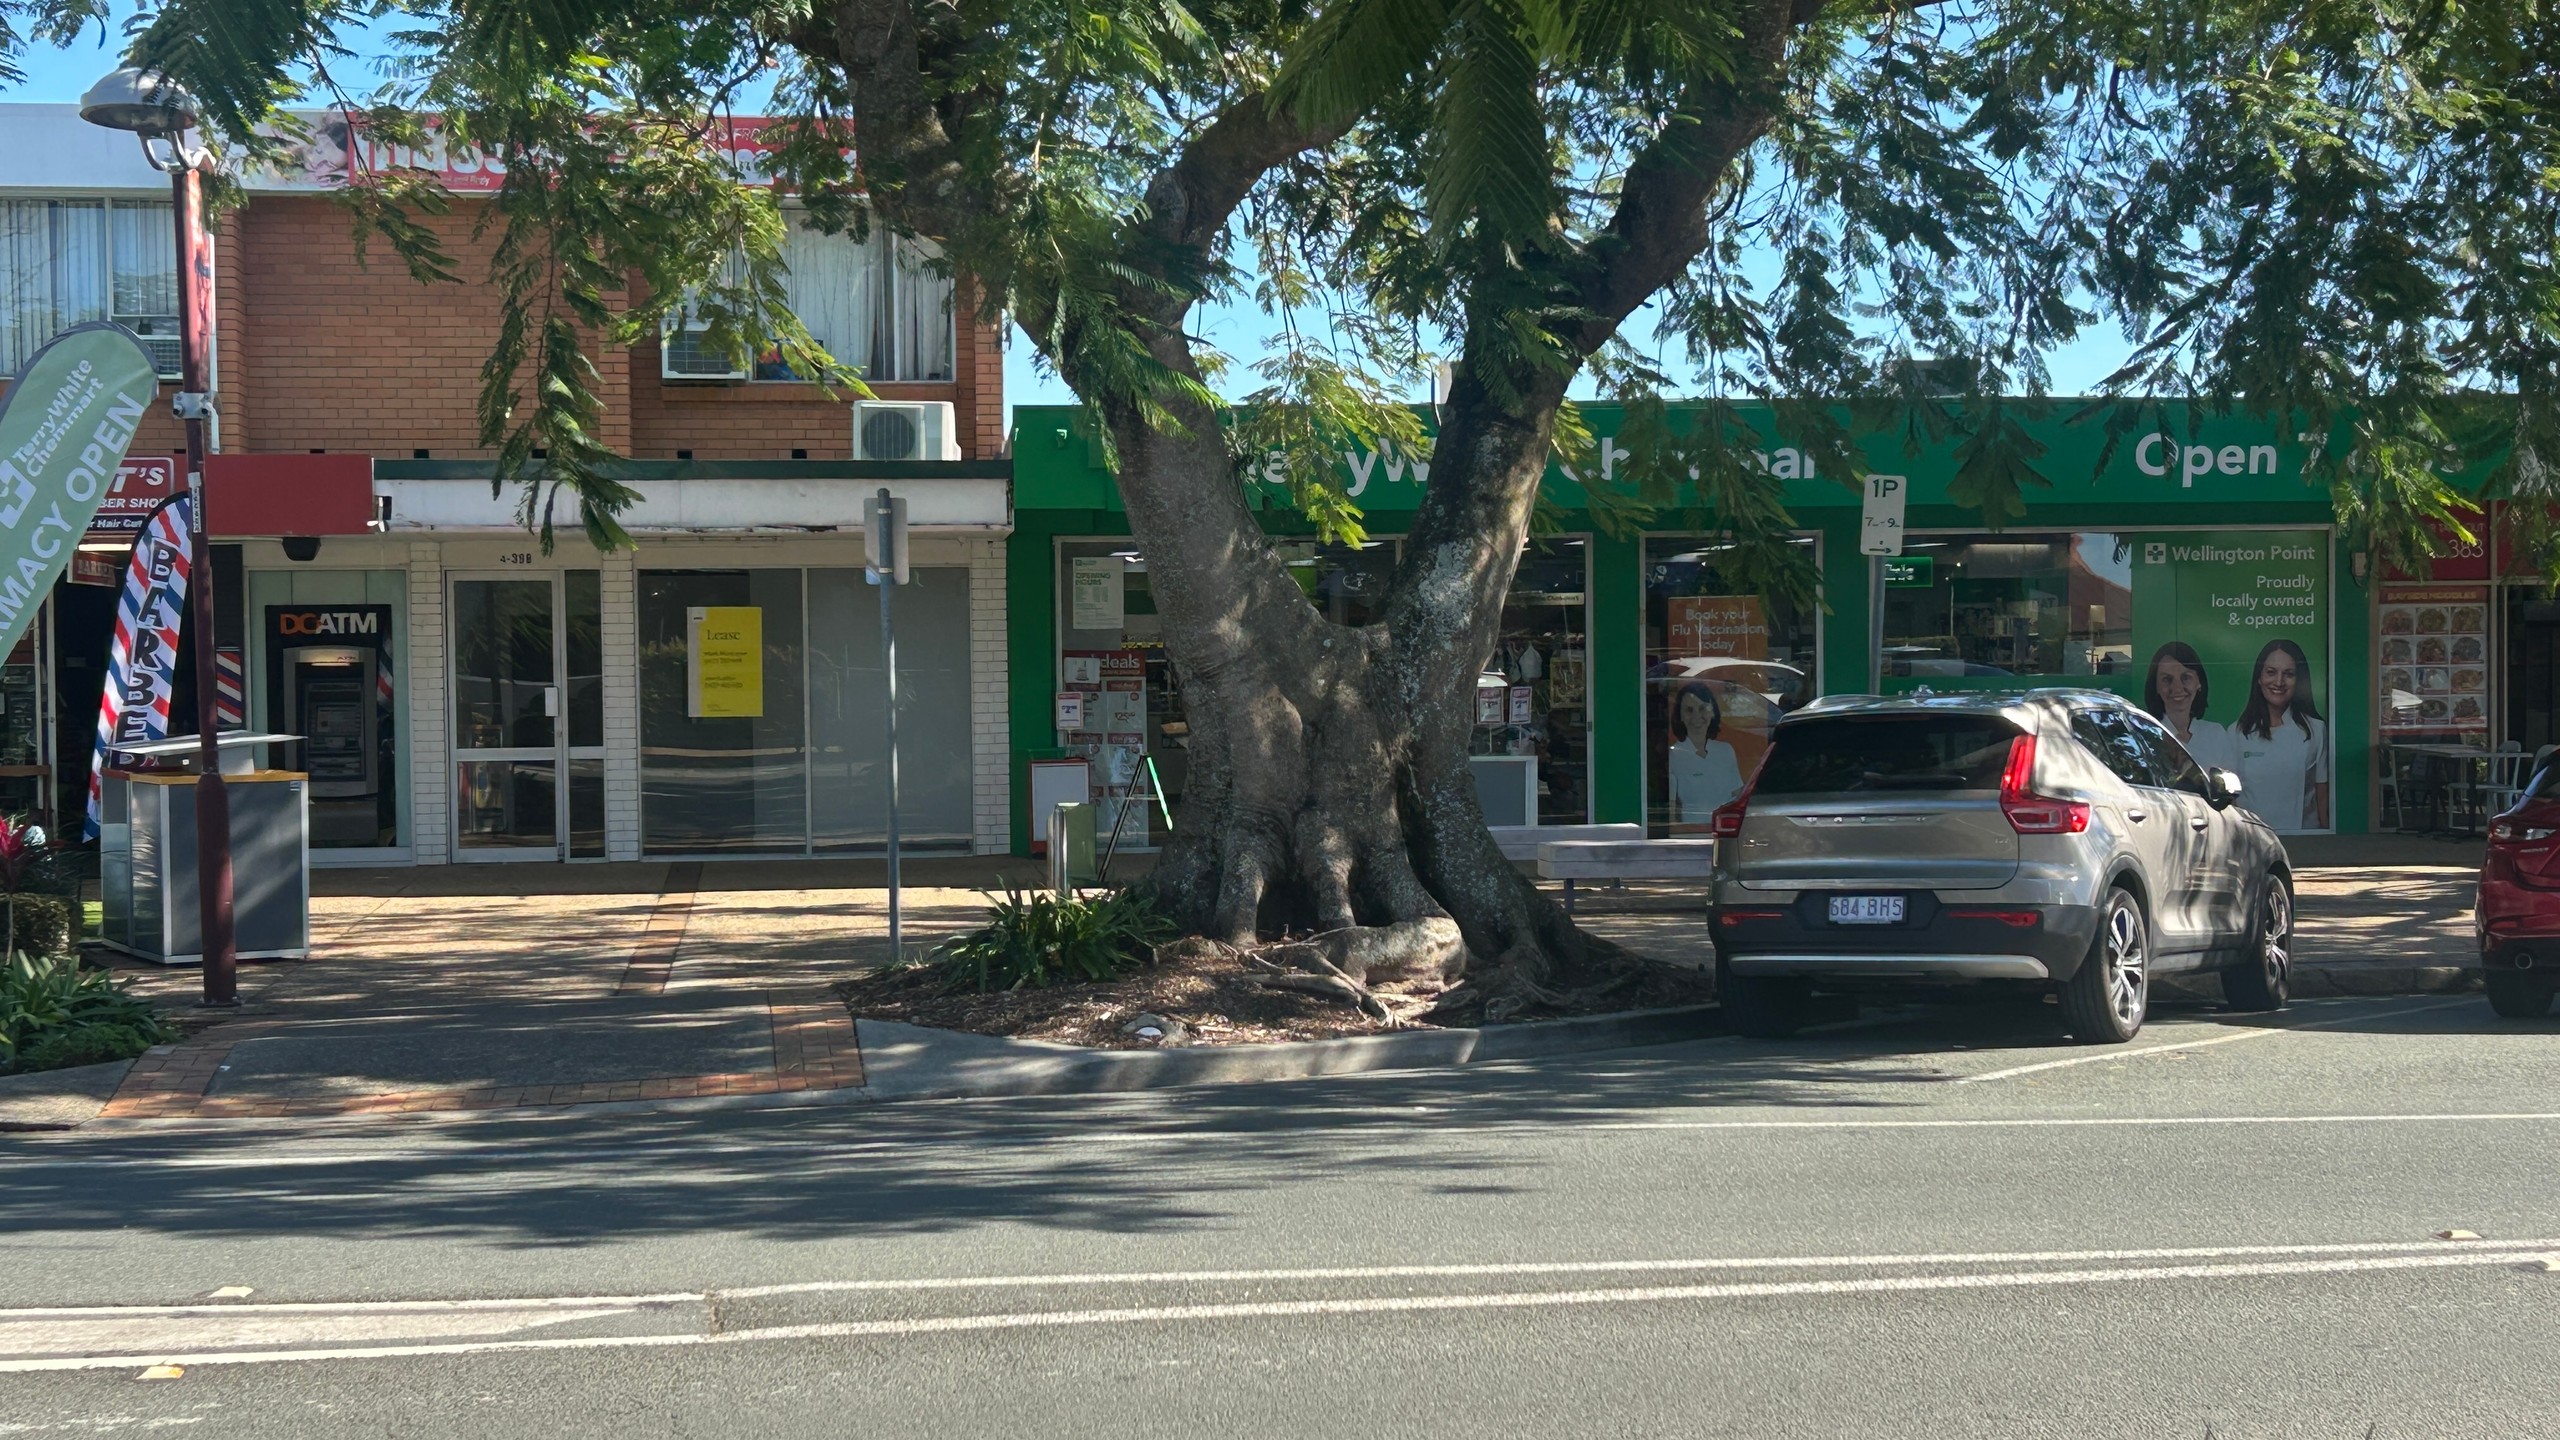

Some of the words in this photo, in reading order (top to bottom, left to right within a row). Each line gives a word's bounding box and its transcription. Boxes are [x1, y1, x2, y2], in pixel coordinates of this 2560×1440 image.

[12, 359, 92, 463] TerryWhite
[26, 378, 104, 477] Chemmart
[66, 391, 145, 502] OPEN
[2135, 432, 2277, 488] Open
[1873, 480, 1899, 498] 1P
[129, 498, 166, 508] SHO
[2172, 545, 2265, 565] Wellington
[2271, 545, 2316, 560] Point
[2256, 575, 2316, 591] Proudly
[2211, 593, 2258, 610] locally
[2263, 593, 2315, 607] owned
[1686, 609, 1719, 620] Book
[1721, 610, 1751, 624] your
[2228, 612, 2240, 625] &
[2245, 612, 2315, 629] operated
[707, 630, 741, 640] Lease
[1672, 625, 1691, 636] Flu
[1694, 624, 1766, 635] Vaccination
[1699, 640, 1736, 652] today
[1100, 653, 1141, 669] deals
